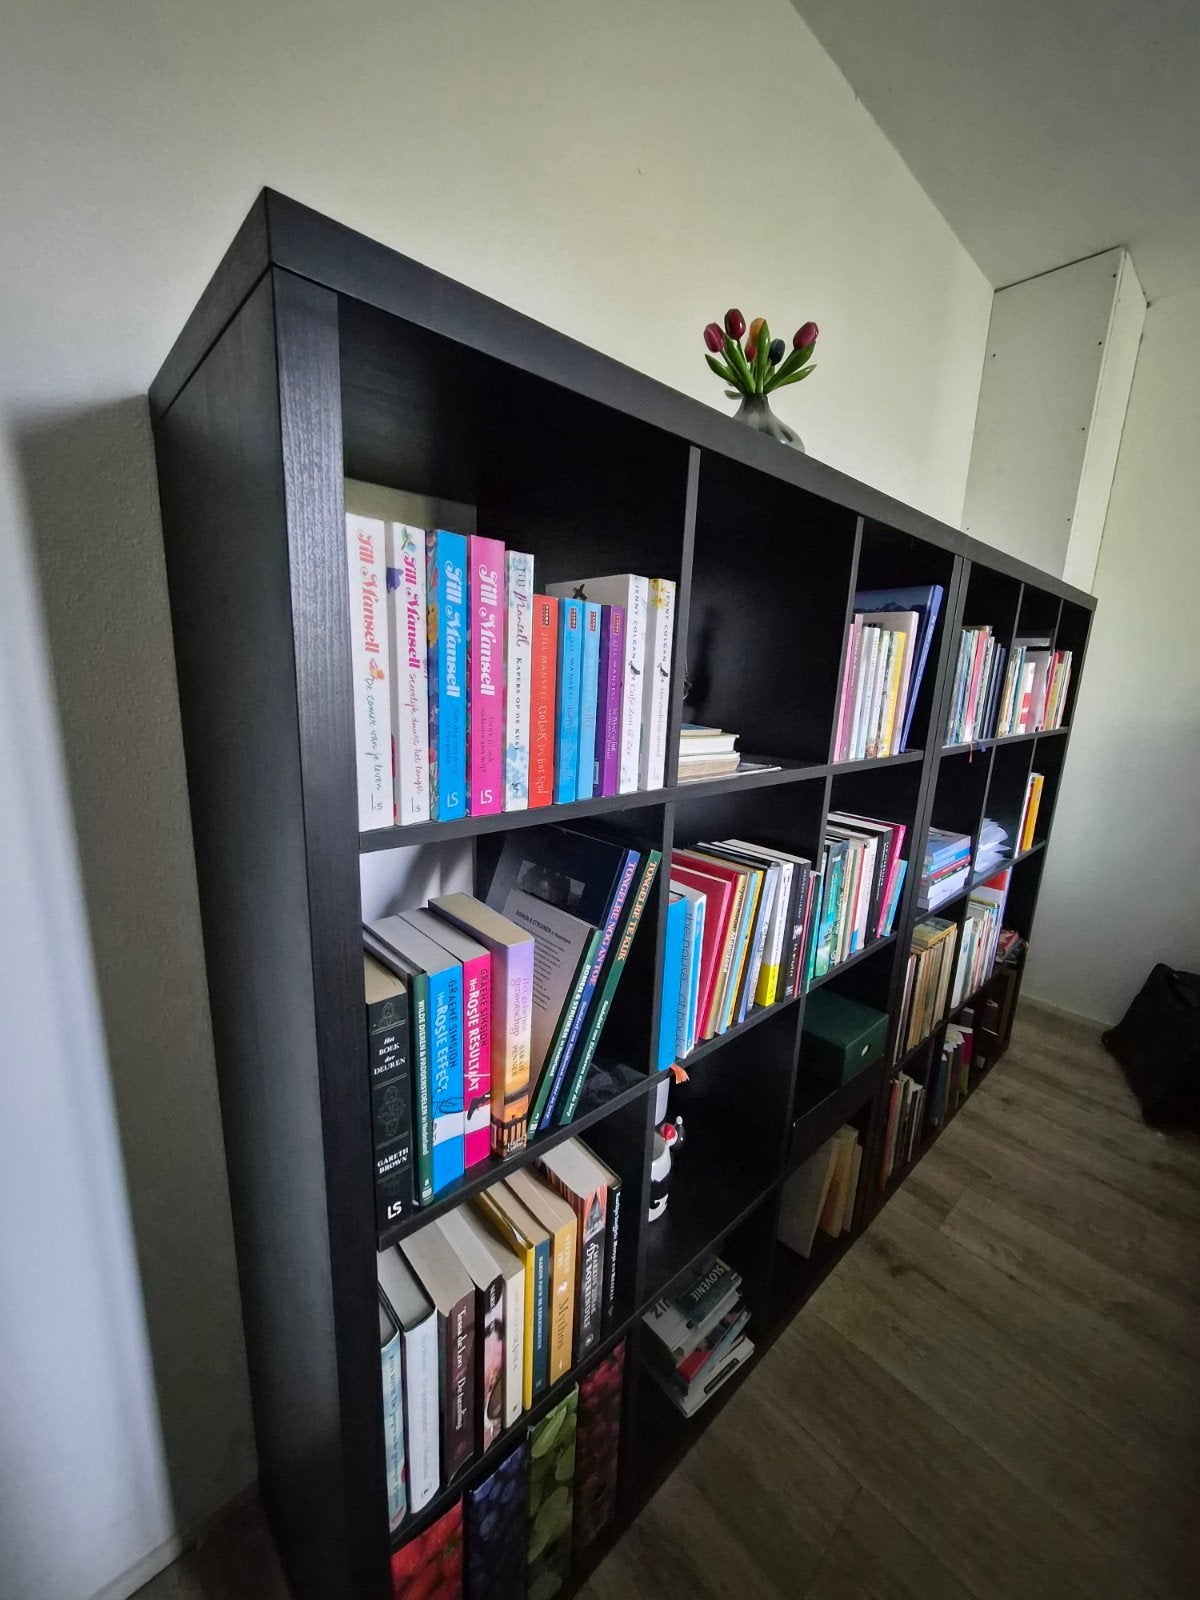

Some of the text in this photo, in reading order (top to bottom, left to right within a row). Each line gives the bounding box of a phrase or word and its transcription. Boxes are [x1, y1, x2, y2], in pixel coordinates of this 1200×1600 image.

[357, 529, 380, 654] Jill Mansell
[513, 566, 530, 648] Jill Mansell
[403, 552, 421, 669] Jill Mansell
[444, 560, 462, 698] Jill Mansell
[478, 564, 498, 696] Jill Mansell
[541, 631, 549, 651] JILL
[540, 656, 548, 701] MANSELL
[515, 697, 521, 710] OP
[370, 730, 378, 750] van
[373, 765, 383, 791] leven
[446, 791, 459, 808] LS
[480, 789, 493, 805] LS
[613, 861, 637, 918] TONGELRE
[617, 861, 657, 961] TONGELRE TE KIJK
[603, 920, 617, 946] NOG
[577, 963, 591, 993] BOMEN
[588, 961, 602, 986] TOE
[675, 911, 693, 1048] the house of books
[448, 979, 458, 1068] GRAEME SIMSION
[468, 990, 480, 1027] ROSIE
[479, 968, 488, 1048] GRAEME SIMSION
[561, 1000, 580, 1040] STRUIKEN
[383, 1036, 395, 1045] Het
[418, 1024, 426, 1050] DIEREN
[436, 1004, 447, 1047] ROSIE
[590, 1028, 600, 1040] van
[379, 1043, 400, 1056] BOEK
[384, 1055, 396, 1063] der
[549, 1046, 563, 1077] Nederland
[579, 1041, 595, 1074] Eindhoven
[374, 1056, 406, 1076] DEUREN
[437, 1047, 449, 1094] EFFECT
[419, 1057, 428, 1115] PADDENSTOELEN
[377, 1147, 409, 1167] GARETH
[379, 1156, 408, 1174] BROWN
[387, 1201, 403, 1220] LS
[689, 1264, 725, 1302] SLOVENIE
[455, 1305, 467, 1368] Tessa de Loo
[556, 1297, 571, 1350] Mythos
[456, 1376, 467, 1393] De
